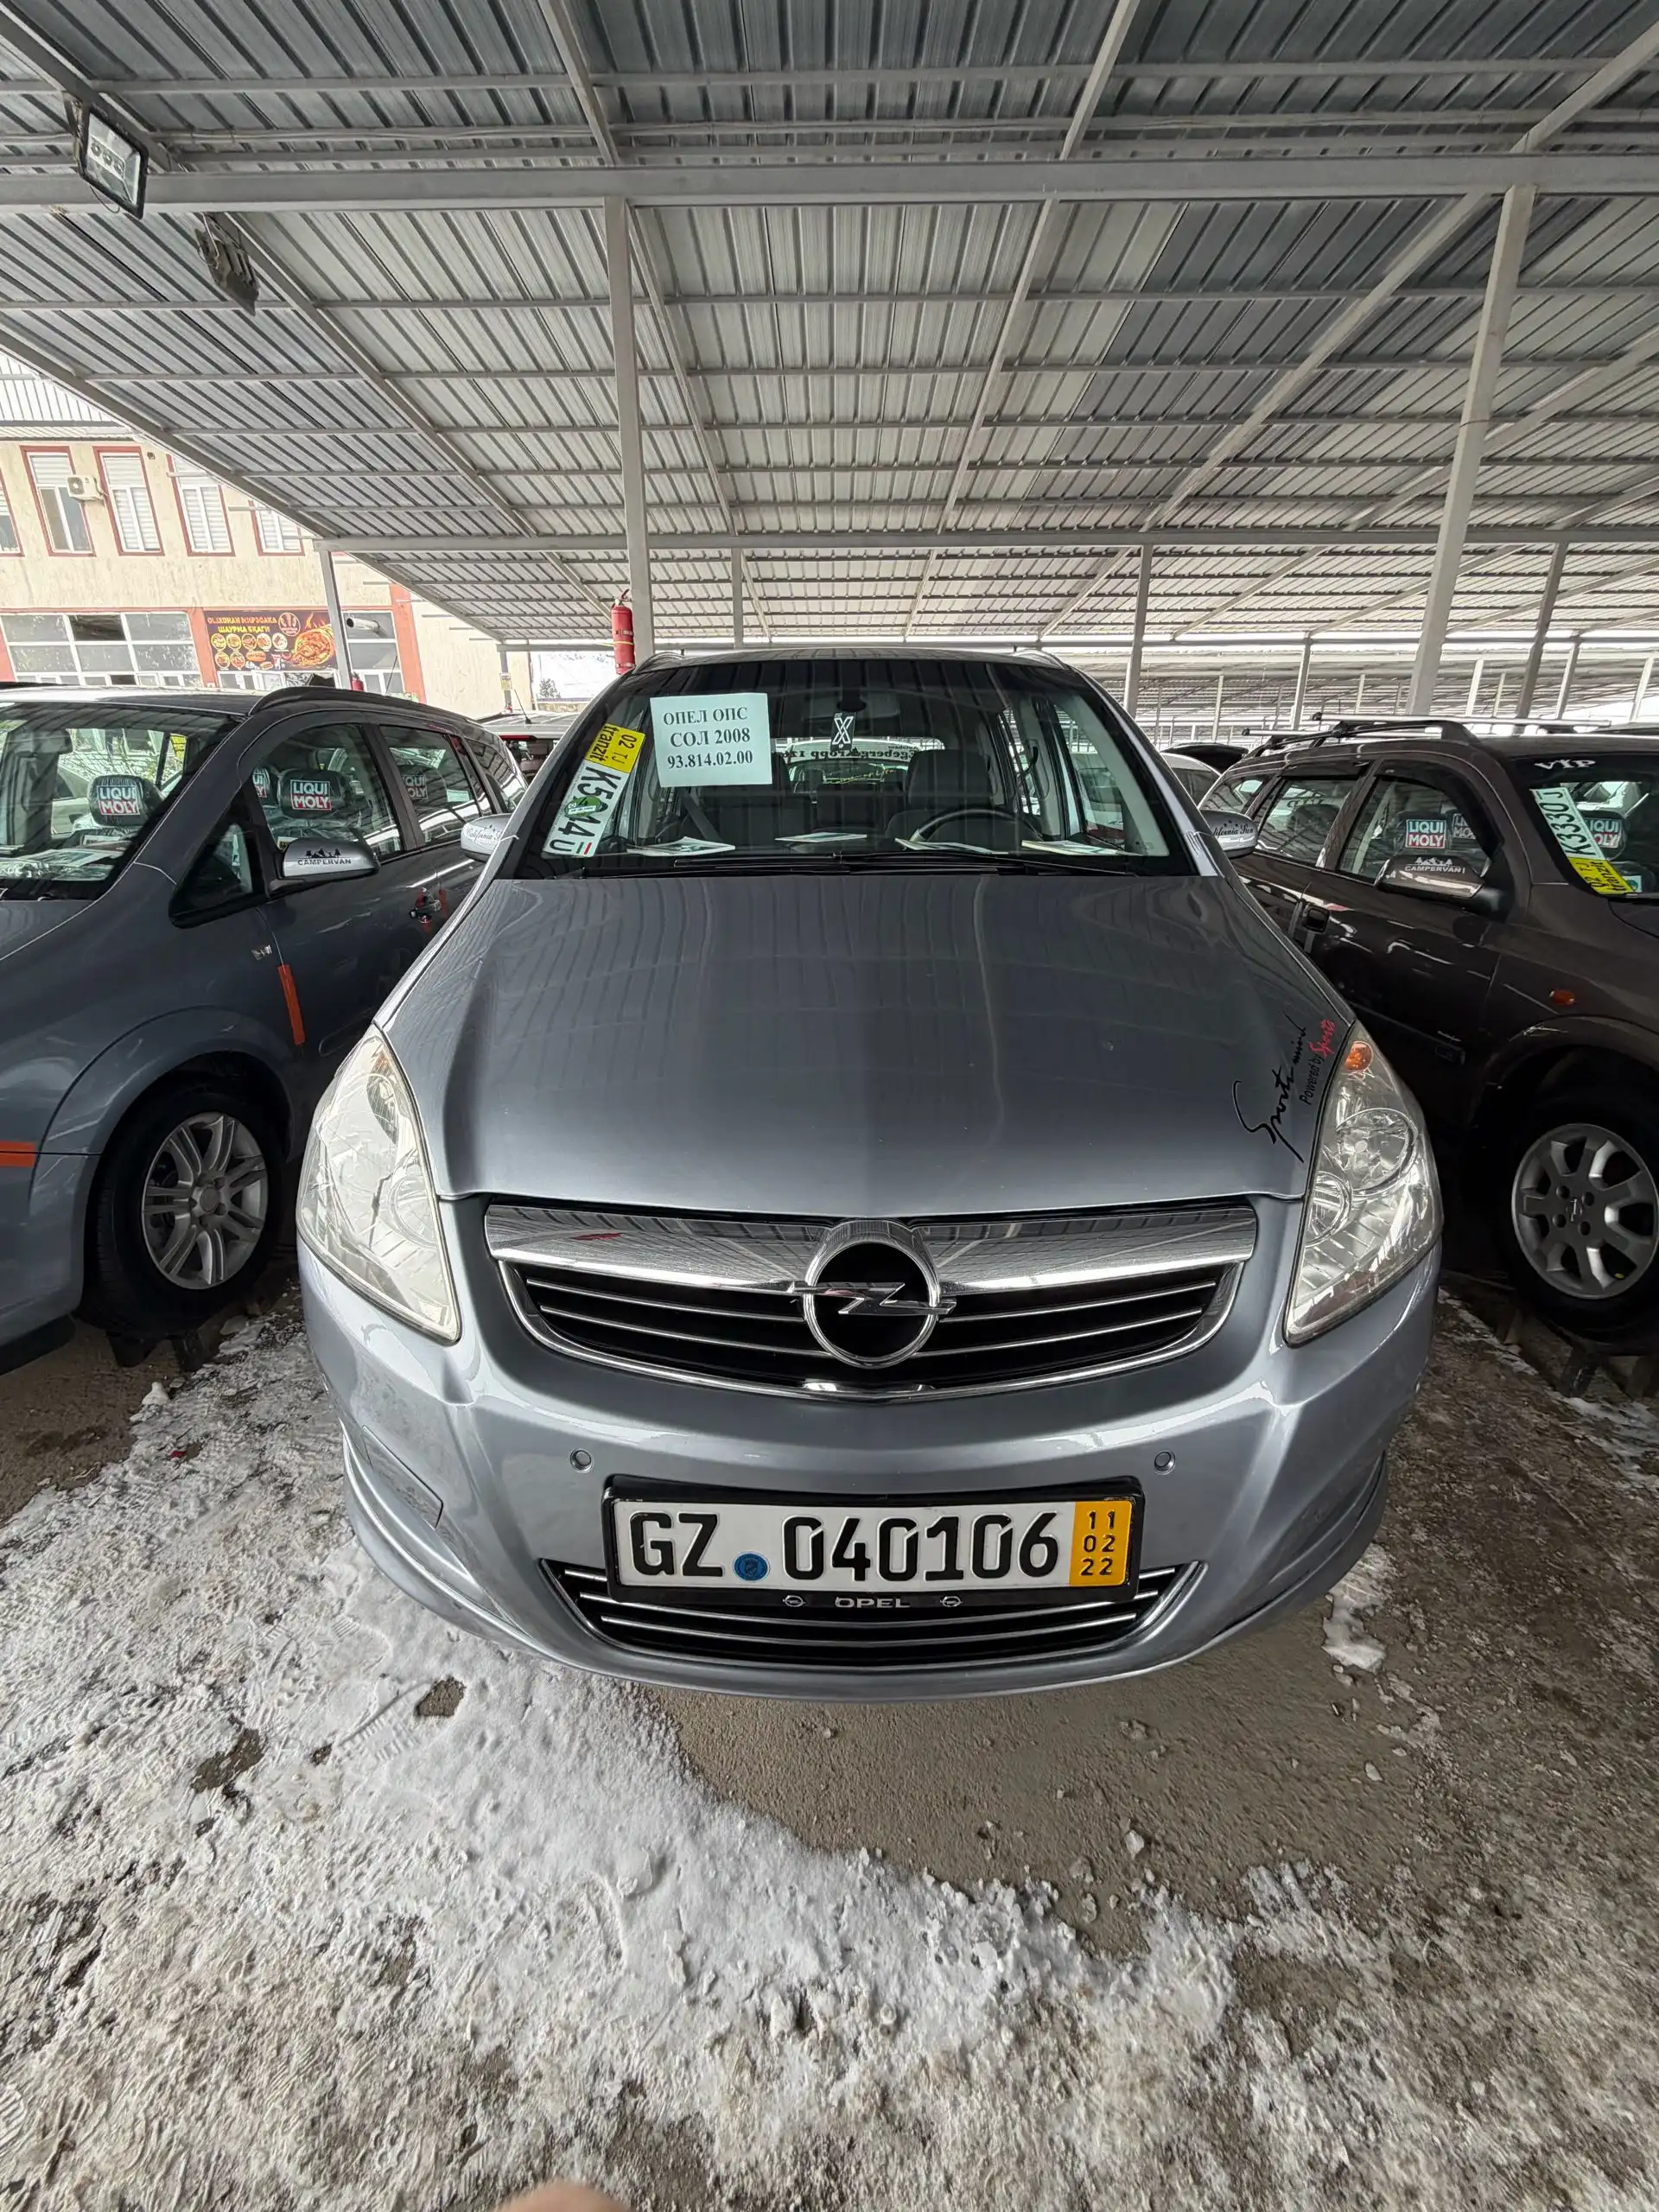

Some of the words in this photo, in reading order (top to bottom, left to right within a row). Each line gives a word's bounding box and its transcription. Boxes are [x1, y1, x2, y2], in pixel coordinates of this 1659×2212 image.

[663, 709, 708, 725] ОПЕЛ
[713, 707, 747, 721] ОПС
[589, 726, 620, 762] tranzit
[617, 734, 638, 749] 02
[671, 730, 709, 747] СОЛ
[715, 728, 750, 744] 2008
[667, 750, 753, 769] 93.814.02.00
[1535, 759, 1596, 770] VIP
[293, 782, 327, 795] LIQUI
[404, 776, 425, 787] QUI
[99, 787, 137, 800] LIQUI
[407, 788, 427, 798] OLY
[100, 800, 137, 814] MOLY
[294, 795, 329, 809] MOLY
[1408, 820, 1444, 834] LIQUI
[1589, 820, 1619, 834] IQUI
[1408, 835, 1444, 847] MOLY
[1594, 833, 1620, 845] OLY
[1404, 865, 1461, 874] CAMPERVAN
[1299, 1060, 1320, 1106] Powered
[1086, 1510, 1116, 1529] 11
[629, 1511, 723, 1577] GZ
[782, 1510, 1060, 1581] 040106
[1083, 1535, 1116, 1553] 02
[1079, 1557, 1114, 1576] 22
[835, 1596, 911, 1608] OPEL
